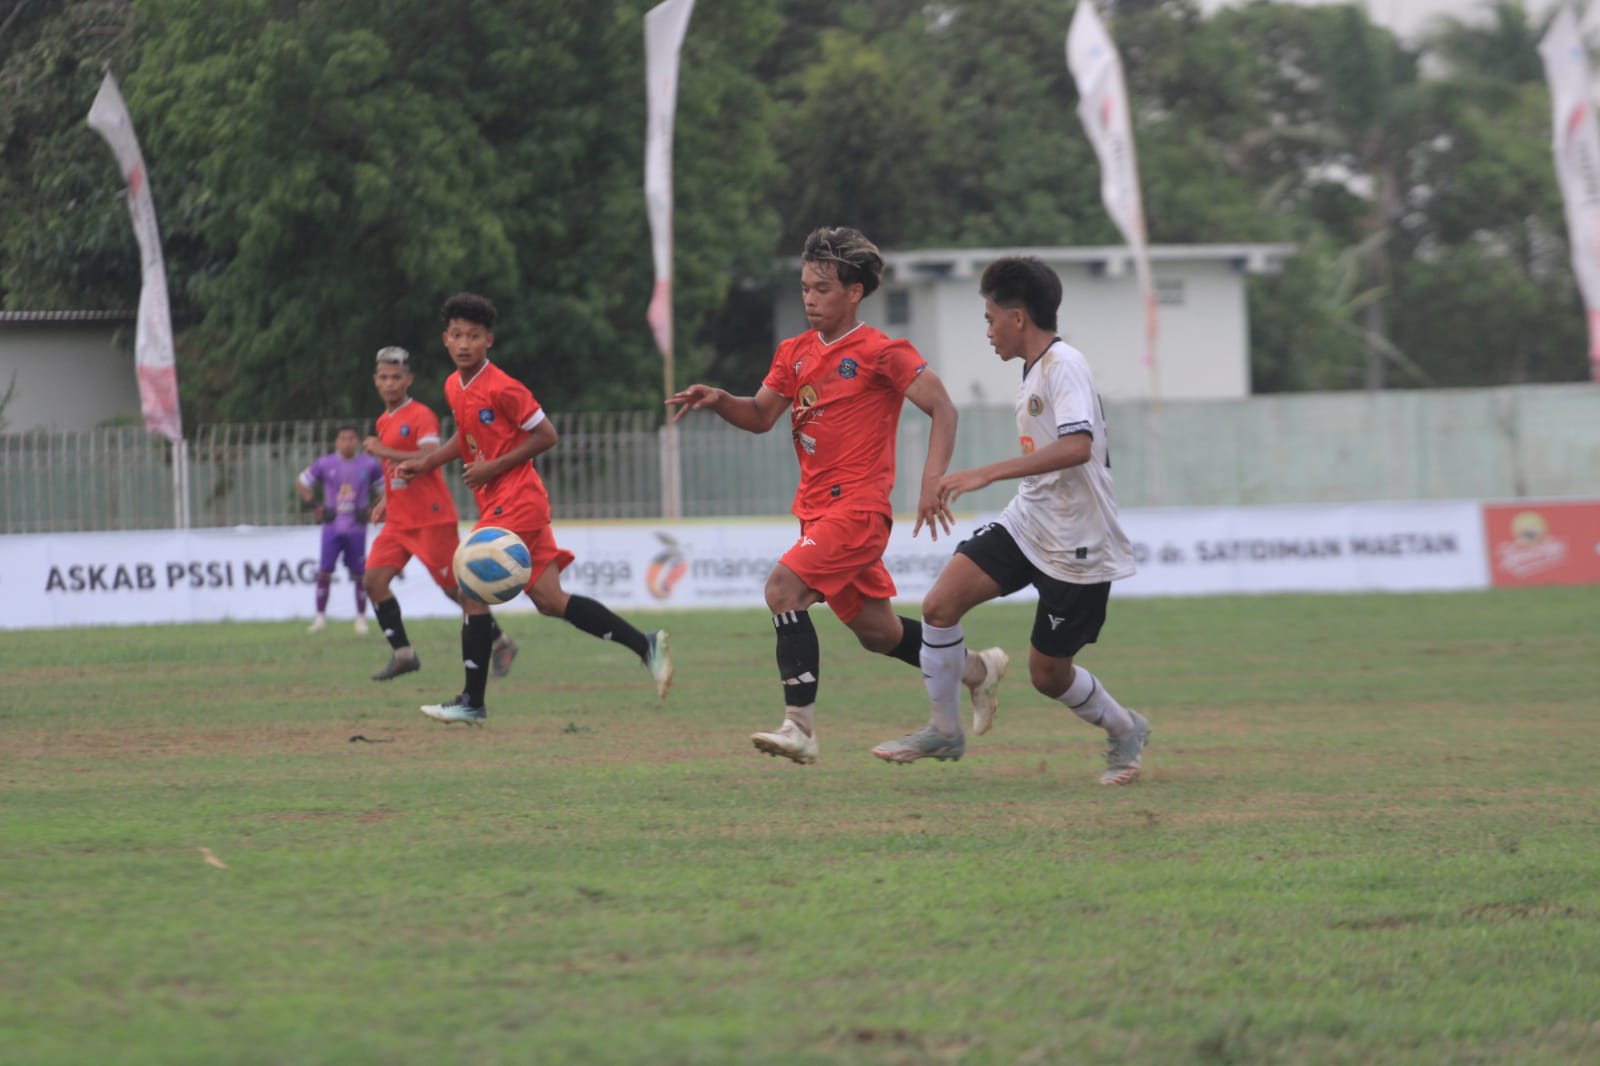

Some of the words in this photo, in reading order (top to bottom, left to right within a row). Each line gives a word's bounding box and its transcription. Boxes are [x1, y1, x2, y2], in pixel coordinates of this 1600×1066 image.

[45, 563, 156, 593] ASKAB
[166, 562, 234, 589] PSSI
[691, 555, 776, 582] mang
